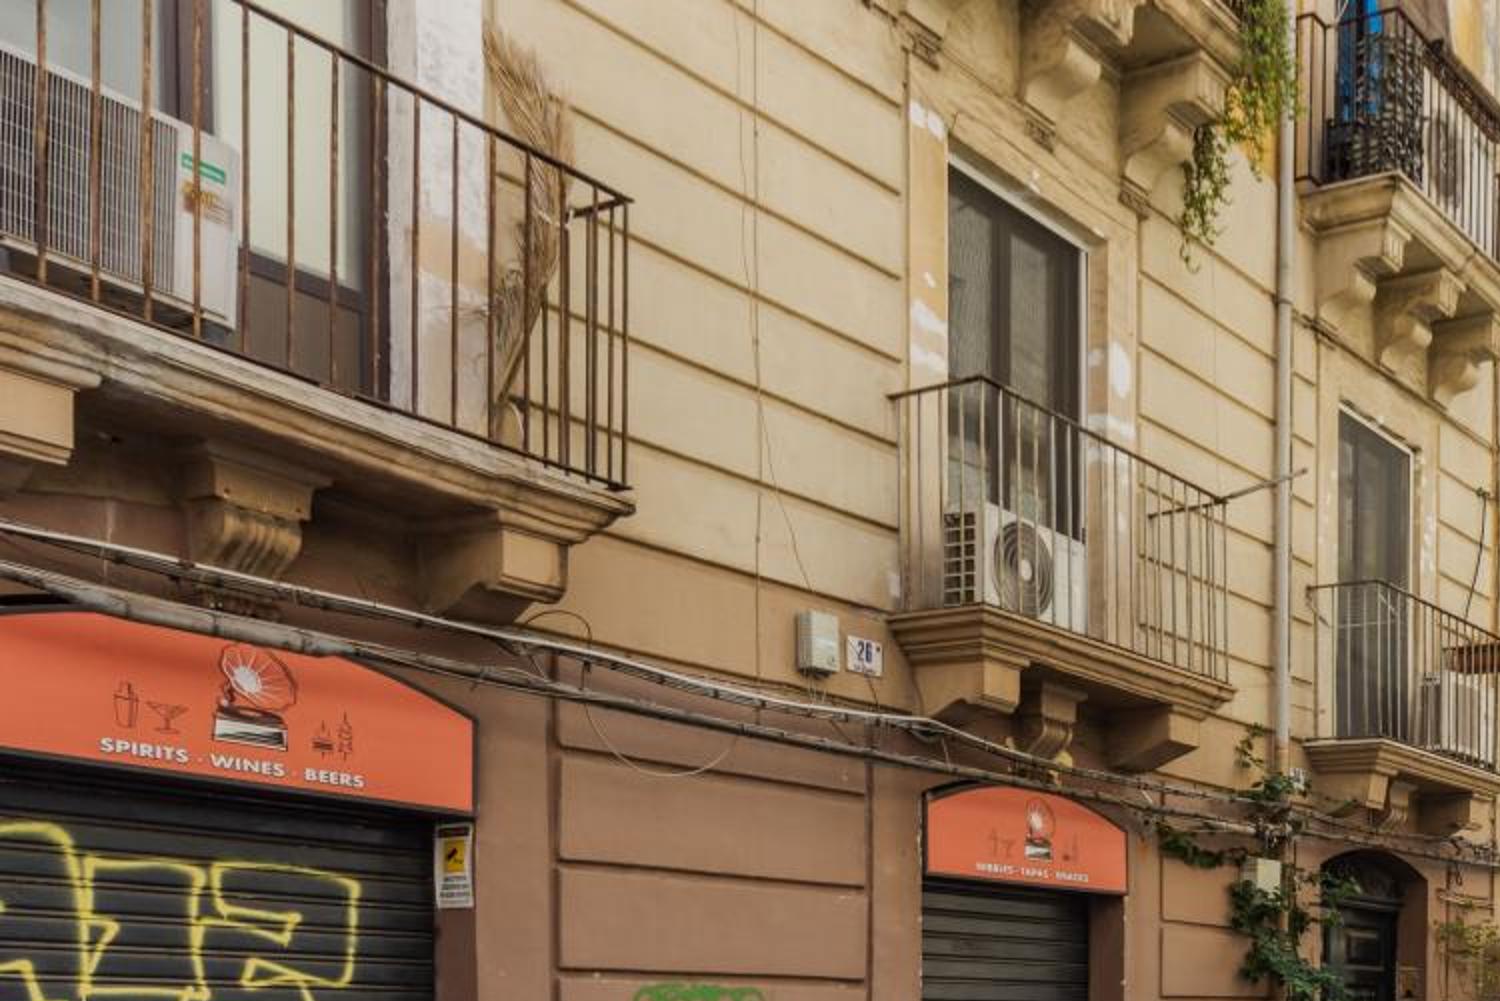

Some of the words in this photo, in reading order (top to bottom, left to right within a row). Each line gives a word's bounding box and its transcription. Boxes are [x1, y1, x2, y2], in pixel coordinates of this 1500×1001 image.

[857, 640, 874, 663] 26
[100, 737, 189, 763] SPIRITS
[210, 753, 286, 777] WINES
[303, 767, 365, 788] BEERS
